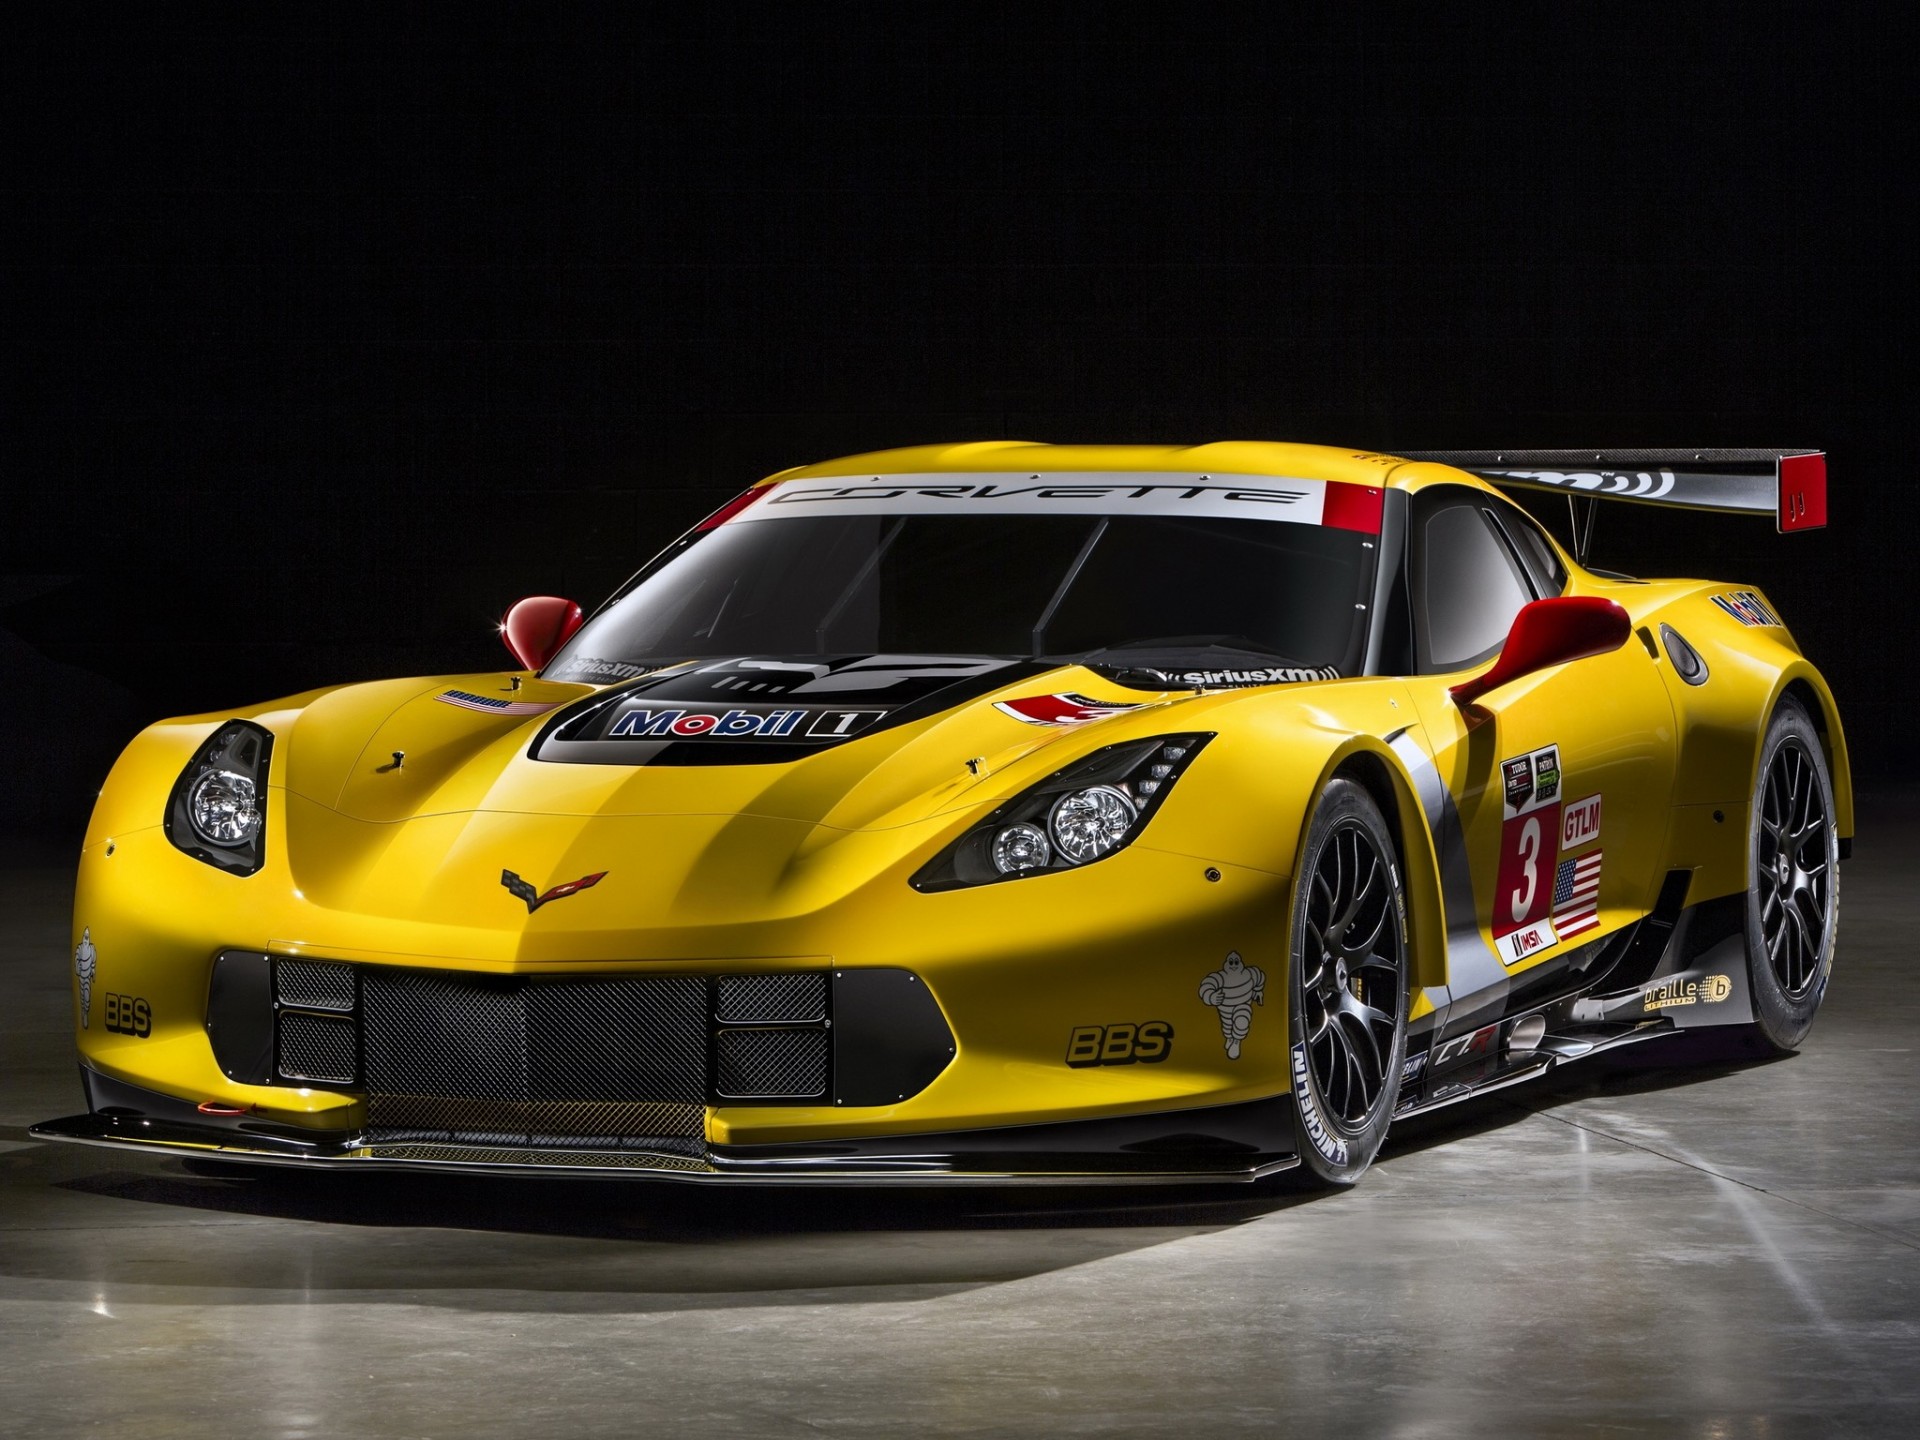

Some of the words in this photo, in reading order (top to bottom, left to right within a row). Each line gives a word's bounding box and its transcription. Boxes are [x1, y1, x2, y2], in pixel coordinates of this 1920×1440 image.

[767, 485, 1310, 504] CORVETTE
[608, 710, 809, 736] Mobil
[1565, 801, 1600, 842] GTLM
[1511, 816, 1541, 923] 3
[1644, 979, 1697, 1003] braille
[1645, 996, 1695, 1011] LITHIUM
[105, 992, 151, 1038] BBS
[1065, 1021, 1175, 1069] BBS
[1293, 1051, 1337, 1158] MICHELIN
